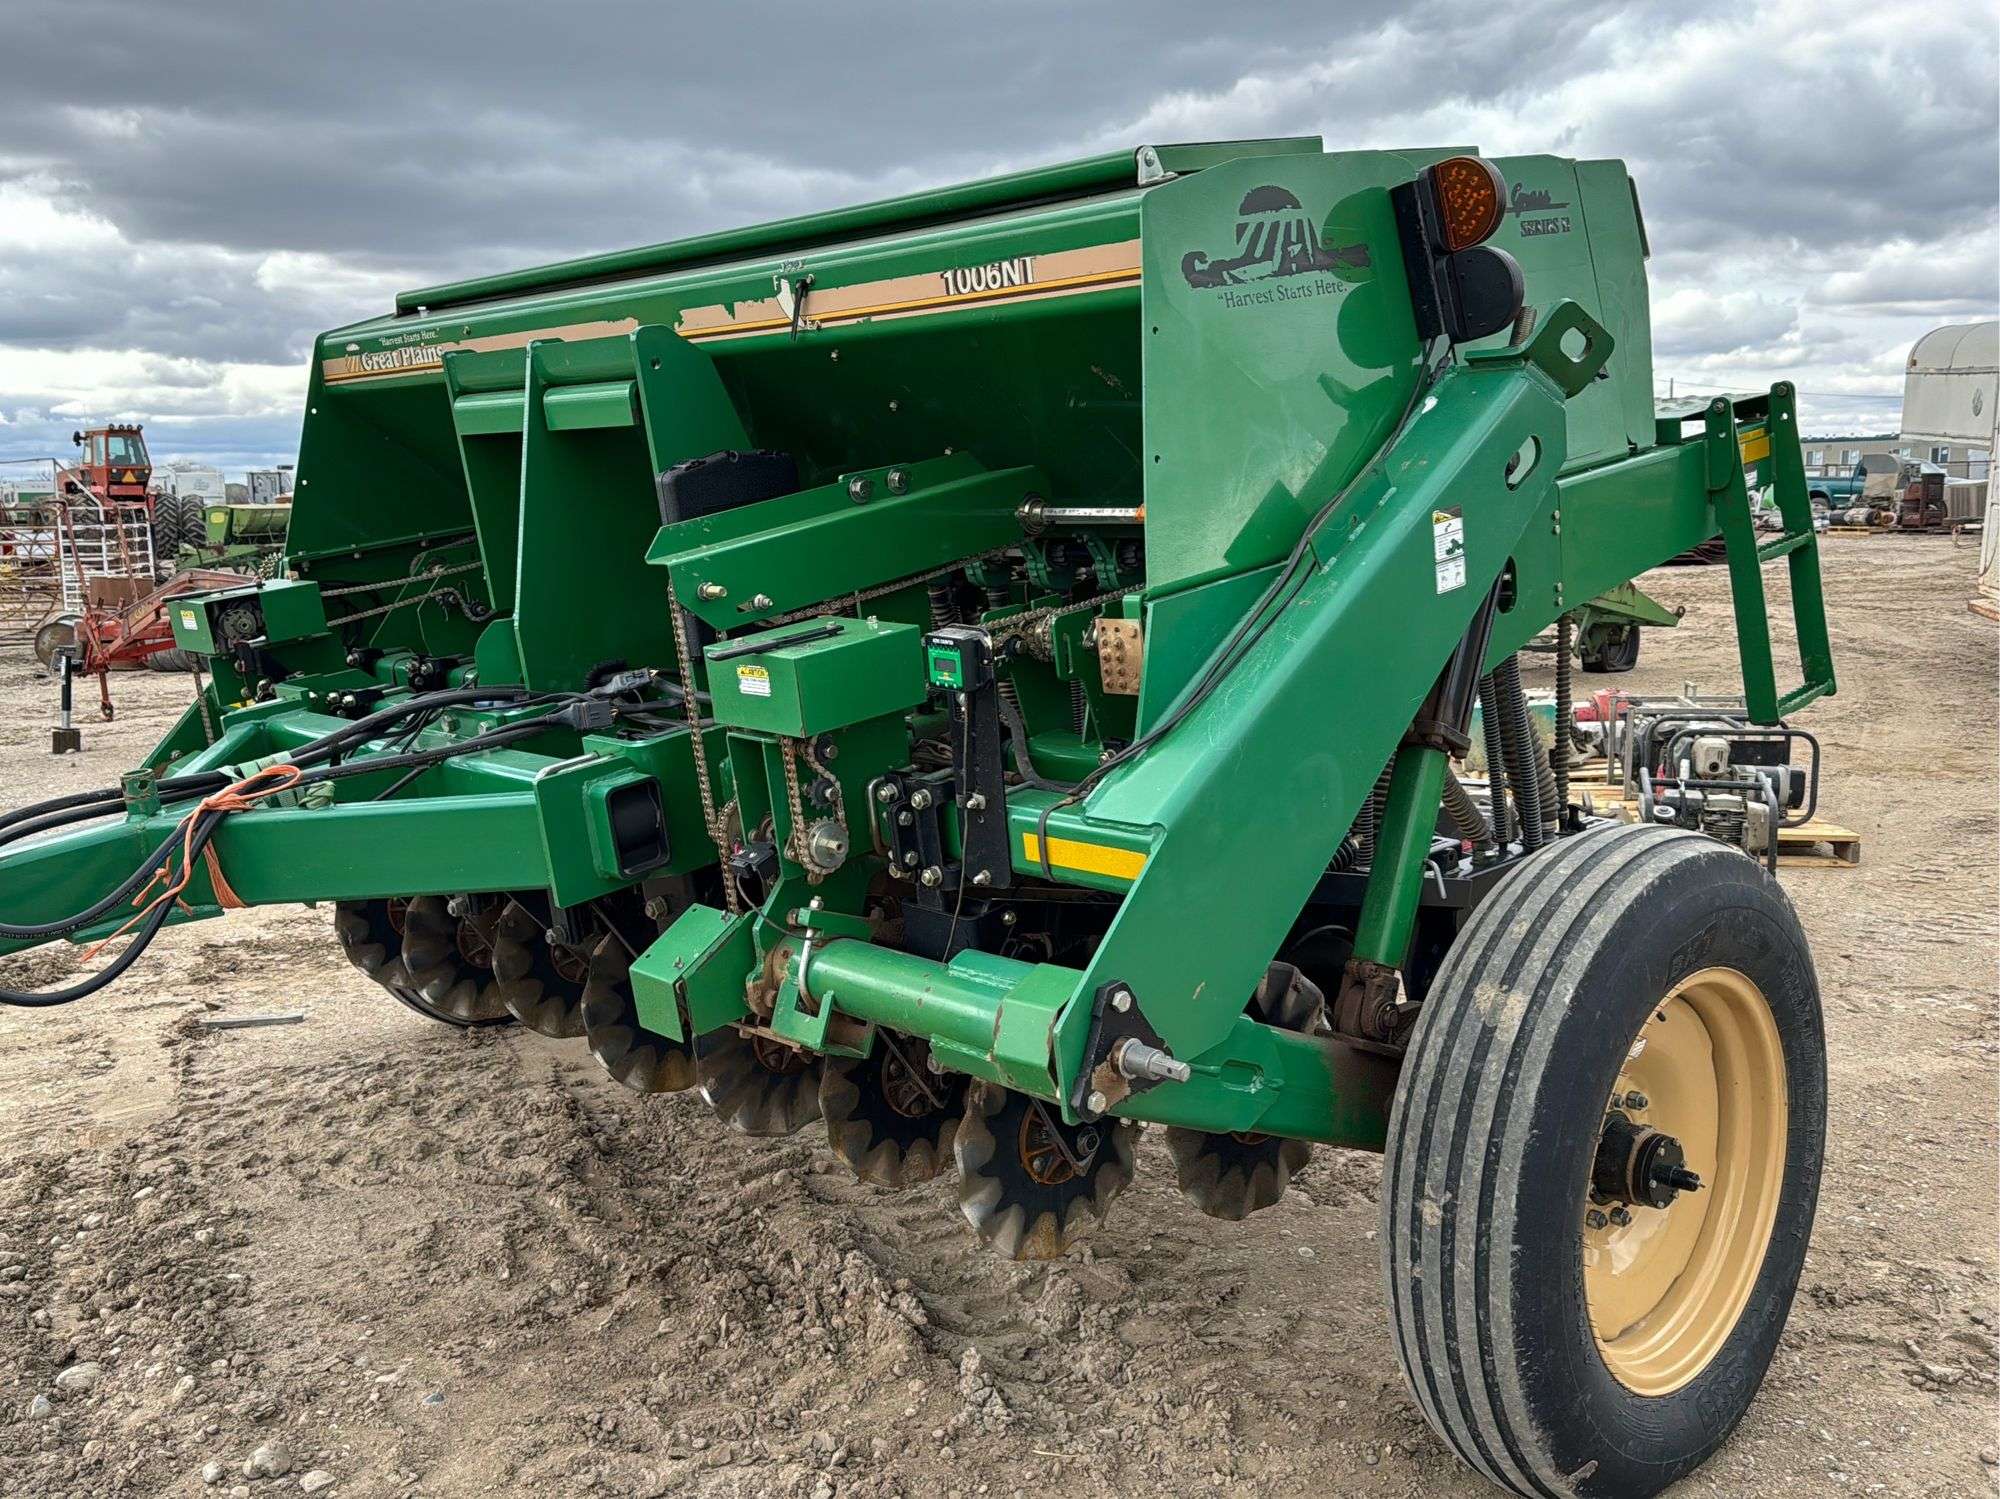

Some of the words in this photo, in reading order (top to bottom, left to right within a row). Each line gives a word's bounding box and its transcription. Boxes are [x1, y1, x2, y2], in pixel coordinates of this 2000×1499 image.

[940, 256, 1036, 296] 1006NT
[1276, 284, 1313, 301] Starts
[361, 349, 402, 371] Great
[401, 342, 443, 367] Plains
